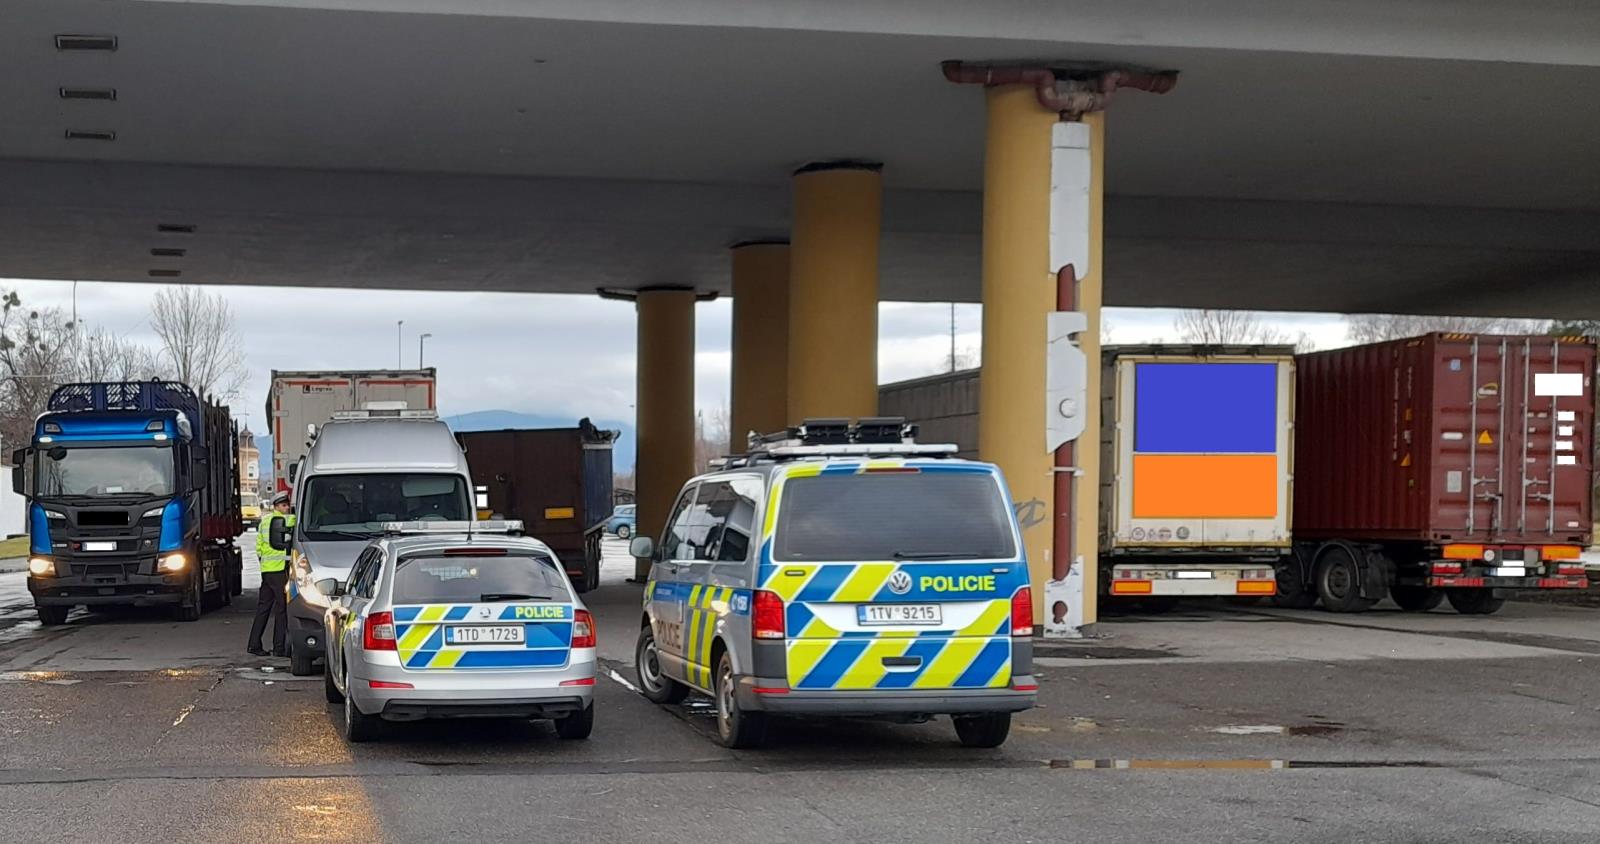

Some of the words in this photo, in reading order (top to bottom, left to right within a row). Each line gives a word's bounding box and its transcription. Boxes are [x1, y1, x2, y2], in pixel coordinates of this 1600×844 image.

[919, 575, 996, 592] POLICIE
[515, 606, 564, 618] POLICIE
[869, 606, 893, 620] 1TV
[902, 606, 935, 620] 9215
[457, 628, 479, 641] 1TD
[489, 628, 519, 641] 1729
